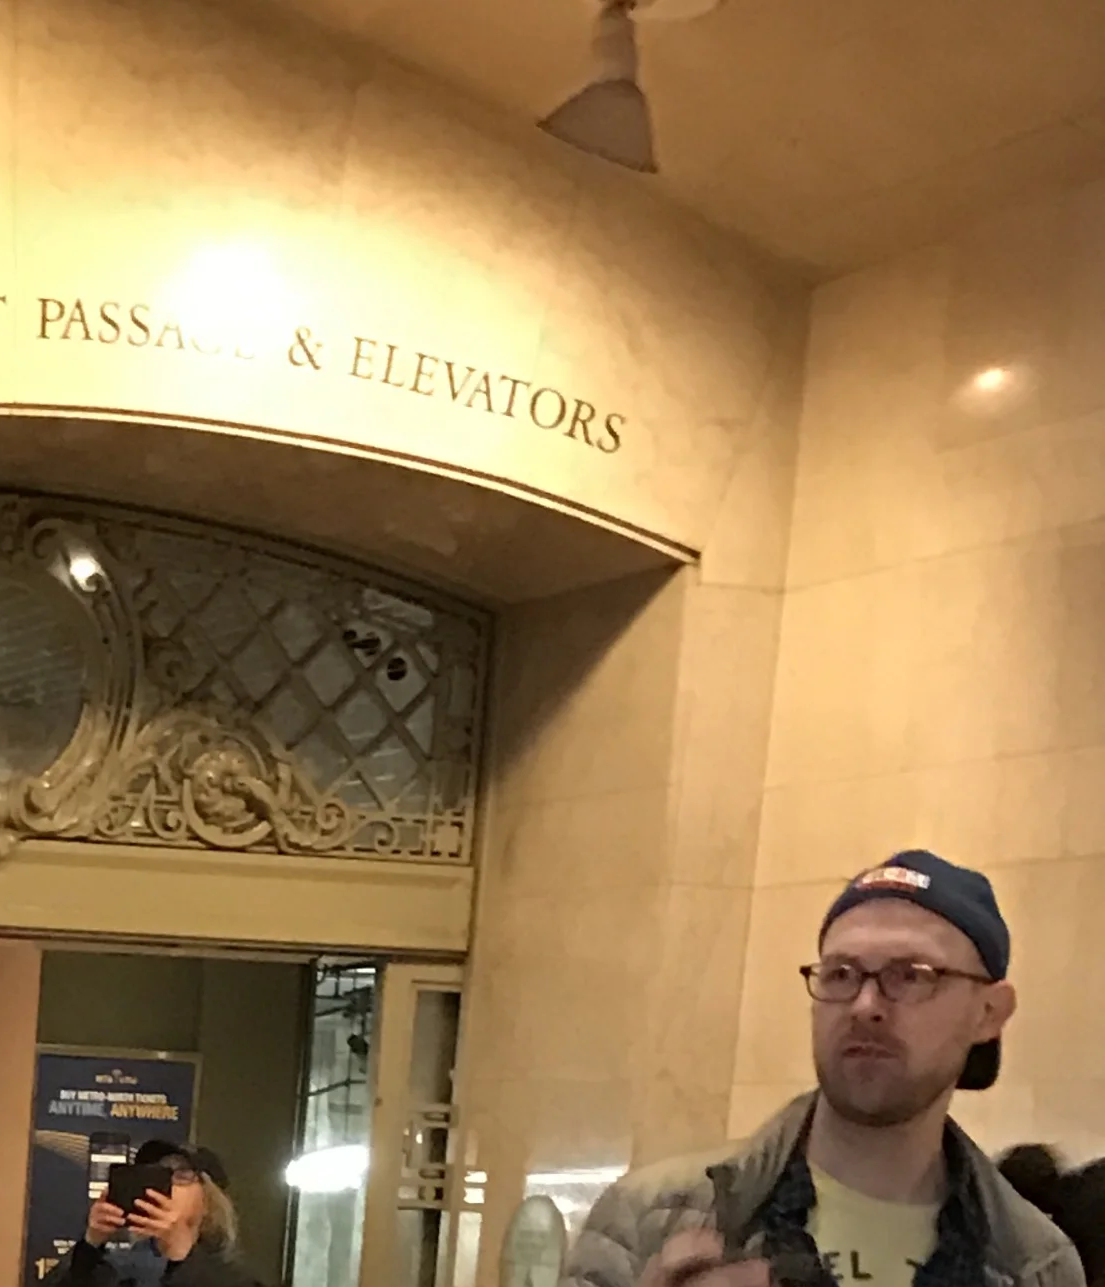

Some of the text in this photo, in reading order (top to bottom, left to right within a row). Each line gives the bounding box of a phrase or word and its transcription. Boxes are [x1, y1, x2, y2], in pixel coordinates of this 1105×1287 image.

[36, 297, 255, 360] PASSA
[288, 326, 323, 371] &
[348, 336, 627, 455] ELEVATORS
[110, 1103, 179, 1121] ANYWHERE
